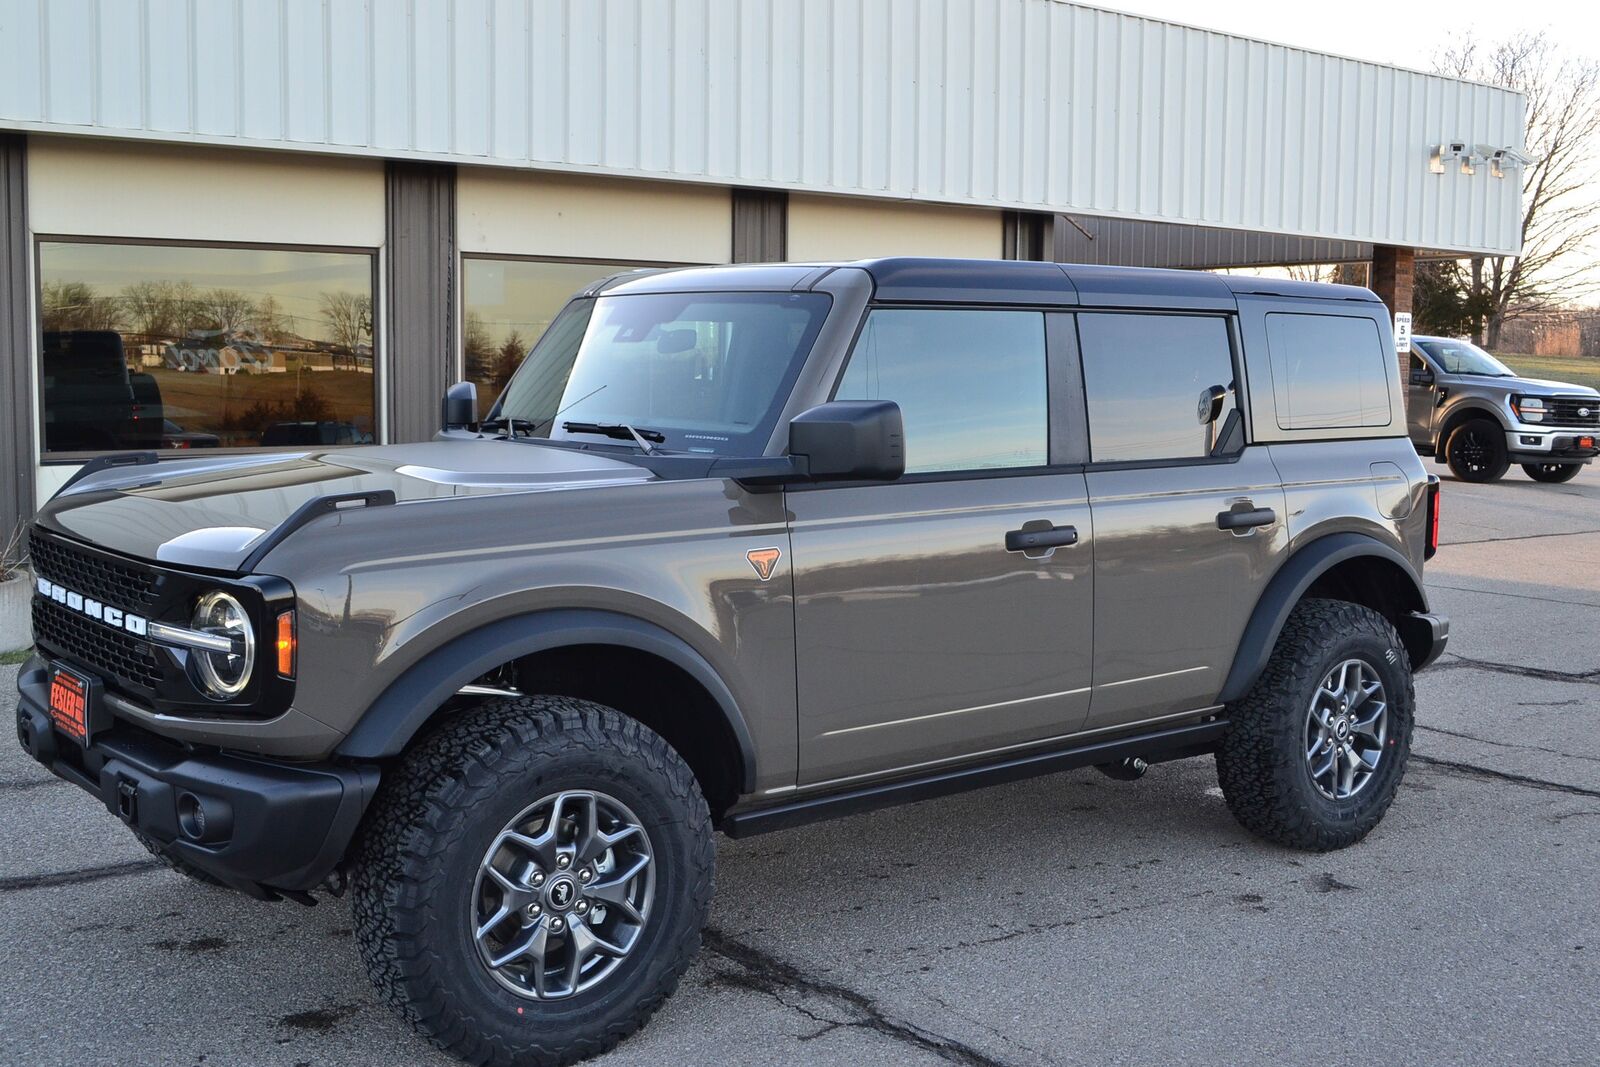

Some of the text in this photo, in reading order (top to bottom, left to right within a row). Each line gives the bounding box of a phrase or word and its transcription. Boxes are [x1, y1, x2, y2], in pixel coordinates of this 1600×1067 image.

[1400, 325, 1406, 335] 5
[37, 577, 147, 636] BRONCO
[50, 682, 76, 719] FESLER
